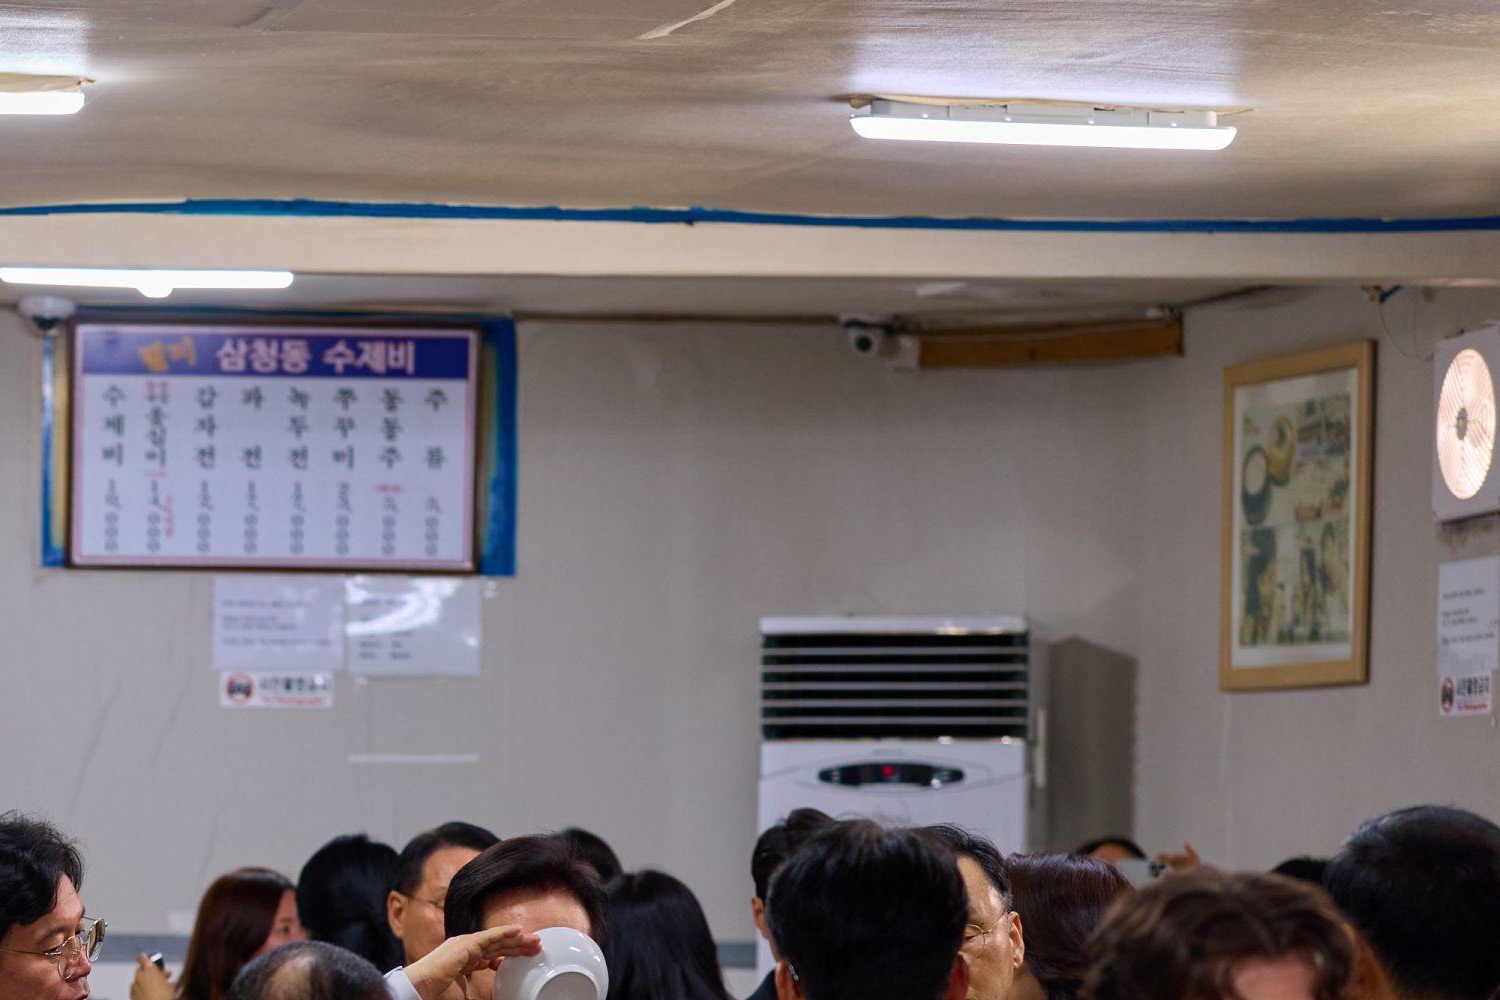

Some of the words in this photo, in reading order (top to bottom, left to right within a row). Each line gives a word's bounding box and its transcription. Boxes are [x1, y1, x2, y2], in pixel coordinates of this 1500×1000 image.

[216, 338, 311, 372] 삼청동
[324, 339, 416, 374] 수제비
[103, 385, 126, 468] 수제비
